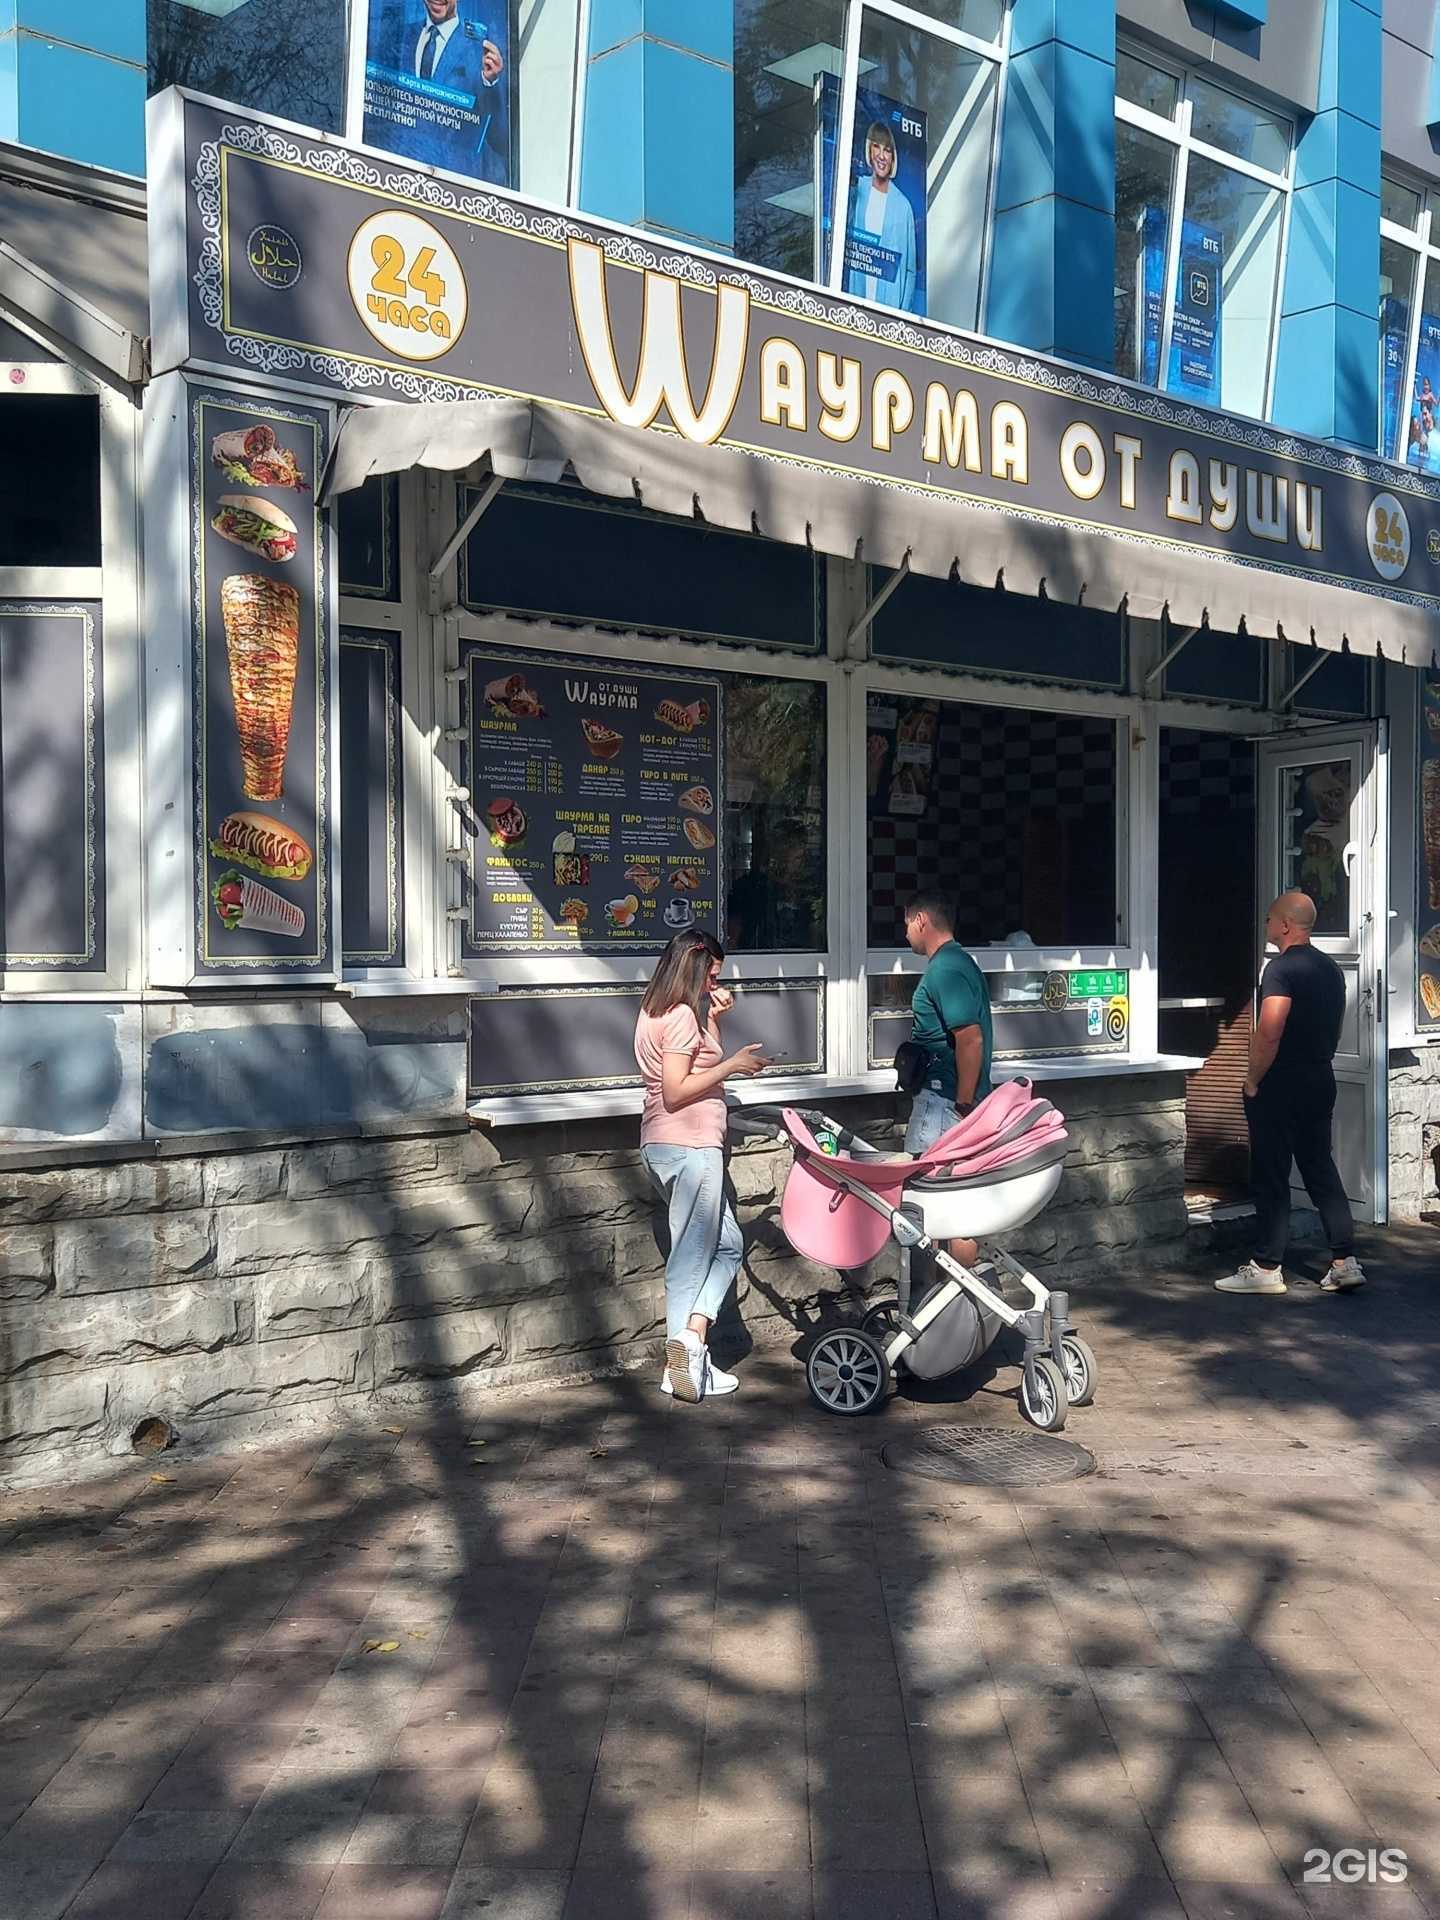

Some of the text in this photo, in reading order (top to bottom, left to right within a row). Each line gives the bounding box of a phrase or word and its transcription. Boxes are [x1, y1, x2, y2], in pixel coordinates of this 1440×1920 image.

[392, 101, 436, 122] КРЕДИТНОЙ
[436, 115, 461, 130] КАРТЫ
[414, 96, 480, 124] ВОЗМОЖНОСТЯМИ
[901, 117, 923, 138] ВТБ
[1203, 237, 1219, 253] ВТБ
[251, 243, 298, 268] حلال
[262, 269, 289, 283] Halal
[371, 235, 446, 306] 24
[1059, 421, 1143, 510] ОТ
[1166, 448, 1323, 552] ДУШИ
[1375, 507, 1403, 548] 24
[599, 683, 639, 695] ОТ ДУШИ
[480, 720, 518, 732] ШАУРМА
[640, 770, 659, 779] ГИРО
[671, 773, 689, 782] ПИТЕ
[555, 810, 610, 823] ШАУРМА НА
[622, 814, 642, 824] ГИРО
[573, 824, 610, 834] ТАРЕЛКЕ
[590, 853, 603, 862] 290
[624, 854, 660, 865] СЭНДВИЧ
[667, 856, 705, 865] НАГГЕТСЫ
[493, 893, 533, 903] ДОБАВКИ
[642, 900, 656, 908] ЧАЙ
[691, 901, 713, 909] КОФЕ
